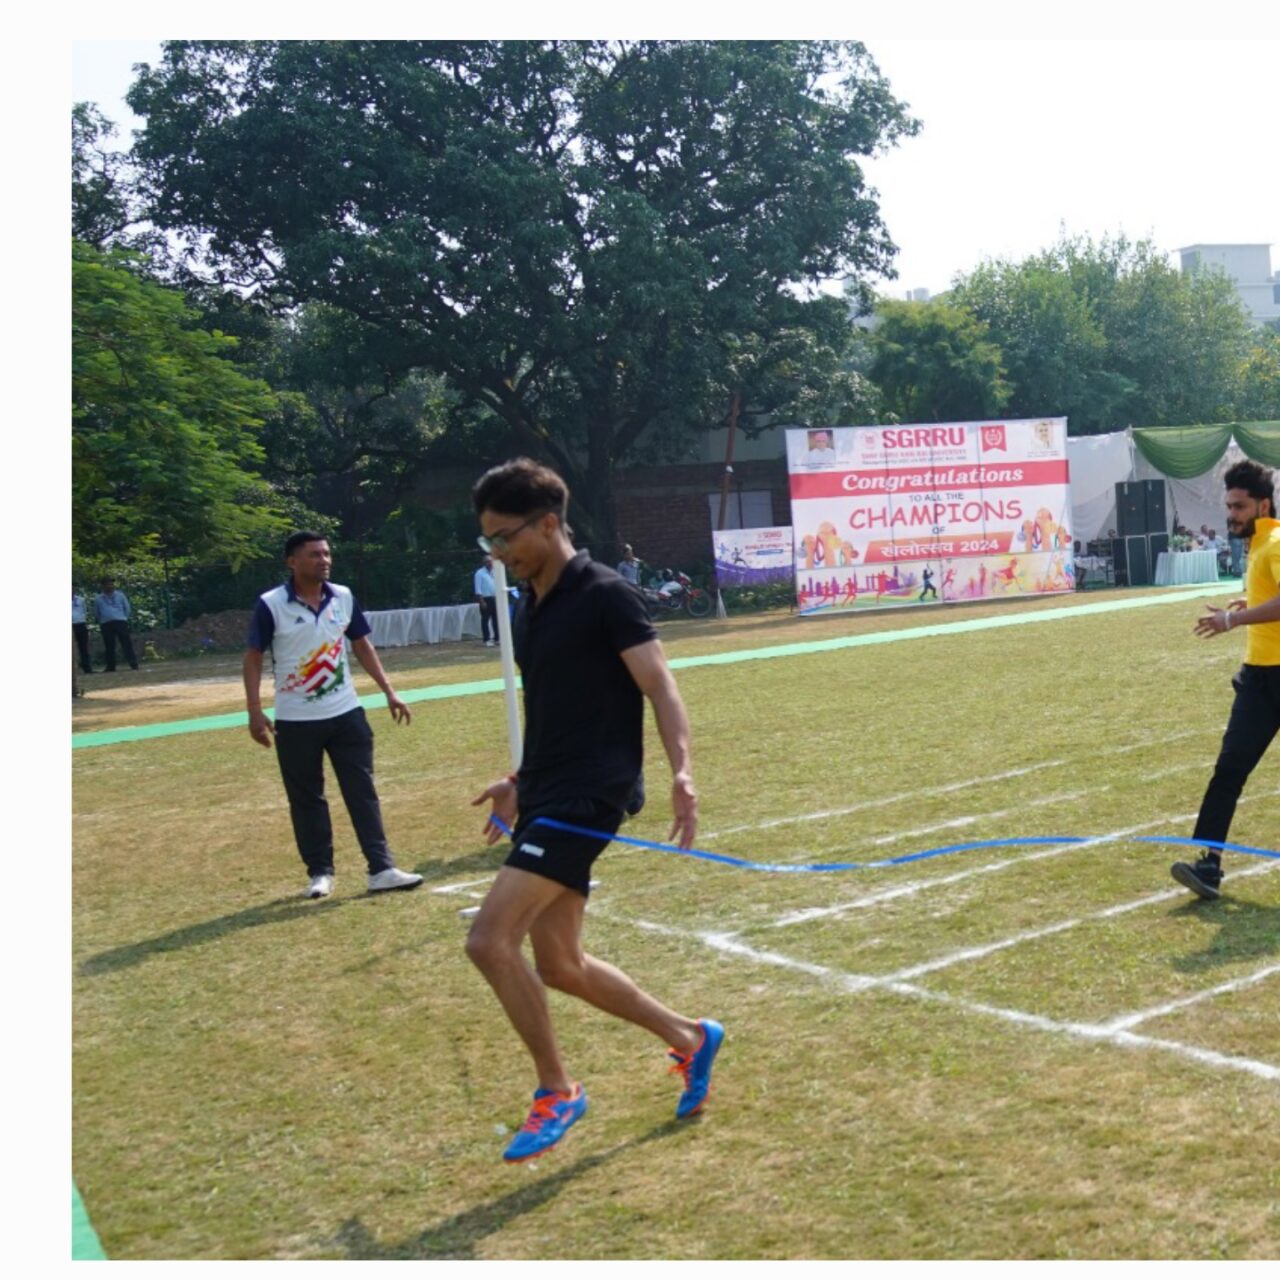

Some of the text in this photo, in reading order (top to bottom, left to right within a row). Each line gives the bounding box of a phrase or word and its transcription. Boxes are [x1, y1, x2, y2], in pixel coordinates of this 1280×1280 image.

[882, 427, 965, 449] SGRRU
[842, 467, 1024, 492] Congratulations
[909, 494, 922, 502] TO
[924, 494, 942, 502] ALL
[850, 500, 1023, 530] CHAMPIONS
[931, 526, 946, 535] OF
[960, 539, 999, 553] 2024
